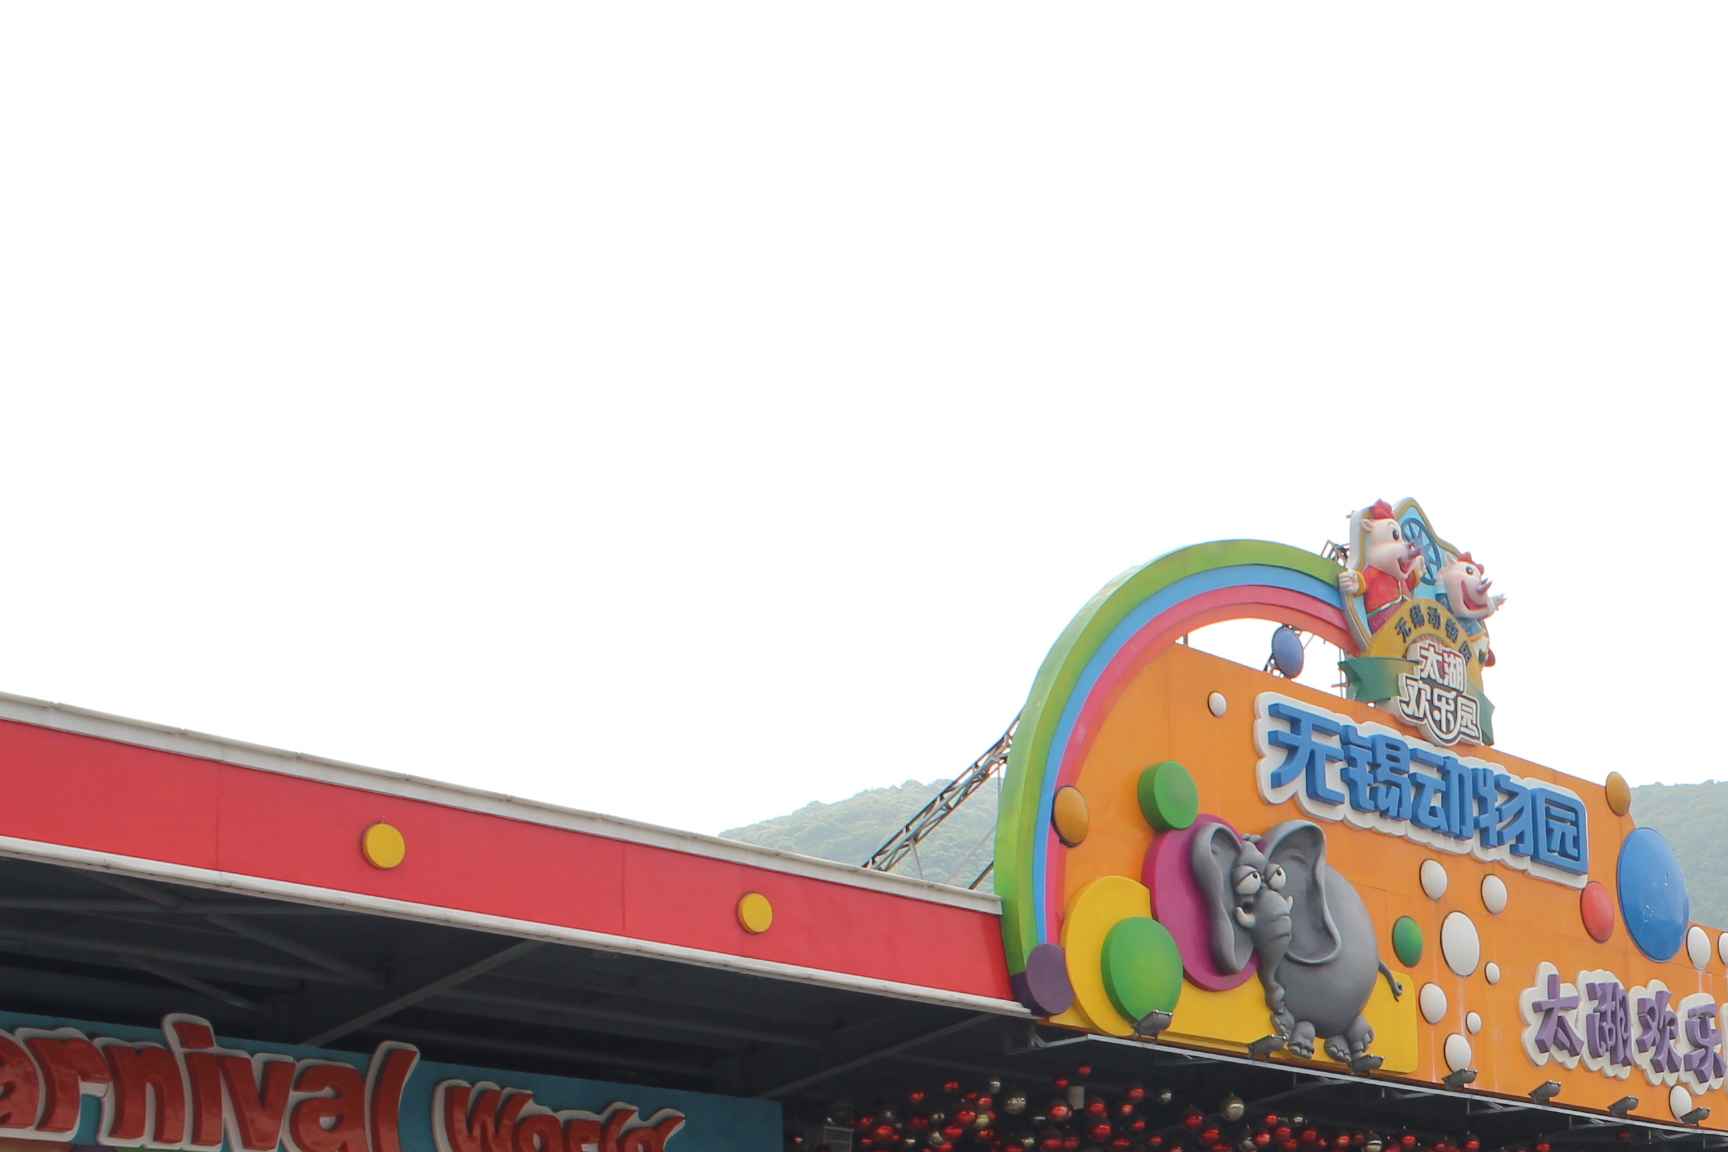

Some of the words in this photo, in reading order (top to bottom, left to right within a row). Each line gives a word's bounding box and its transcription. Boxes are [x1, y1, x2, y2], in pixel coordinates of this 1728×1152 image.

[1419, 645, 1465, 692] 太湖
[1400, 680, 1480, 738] 欢乐园
[1267, 702, 1589, 876] 无锡动物园
